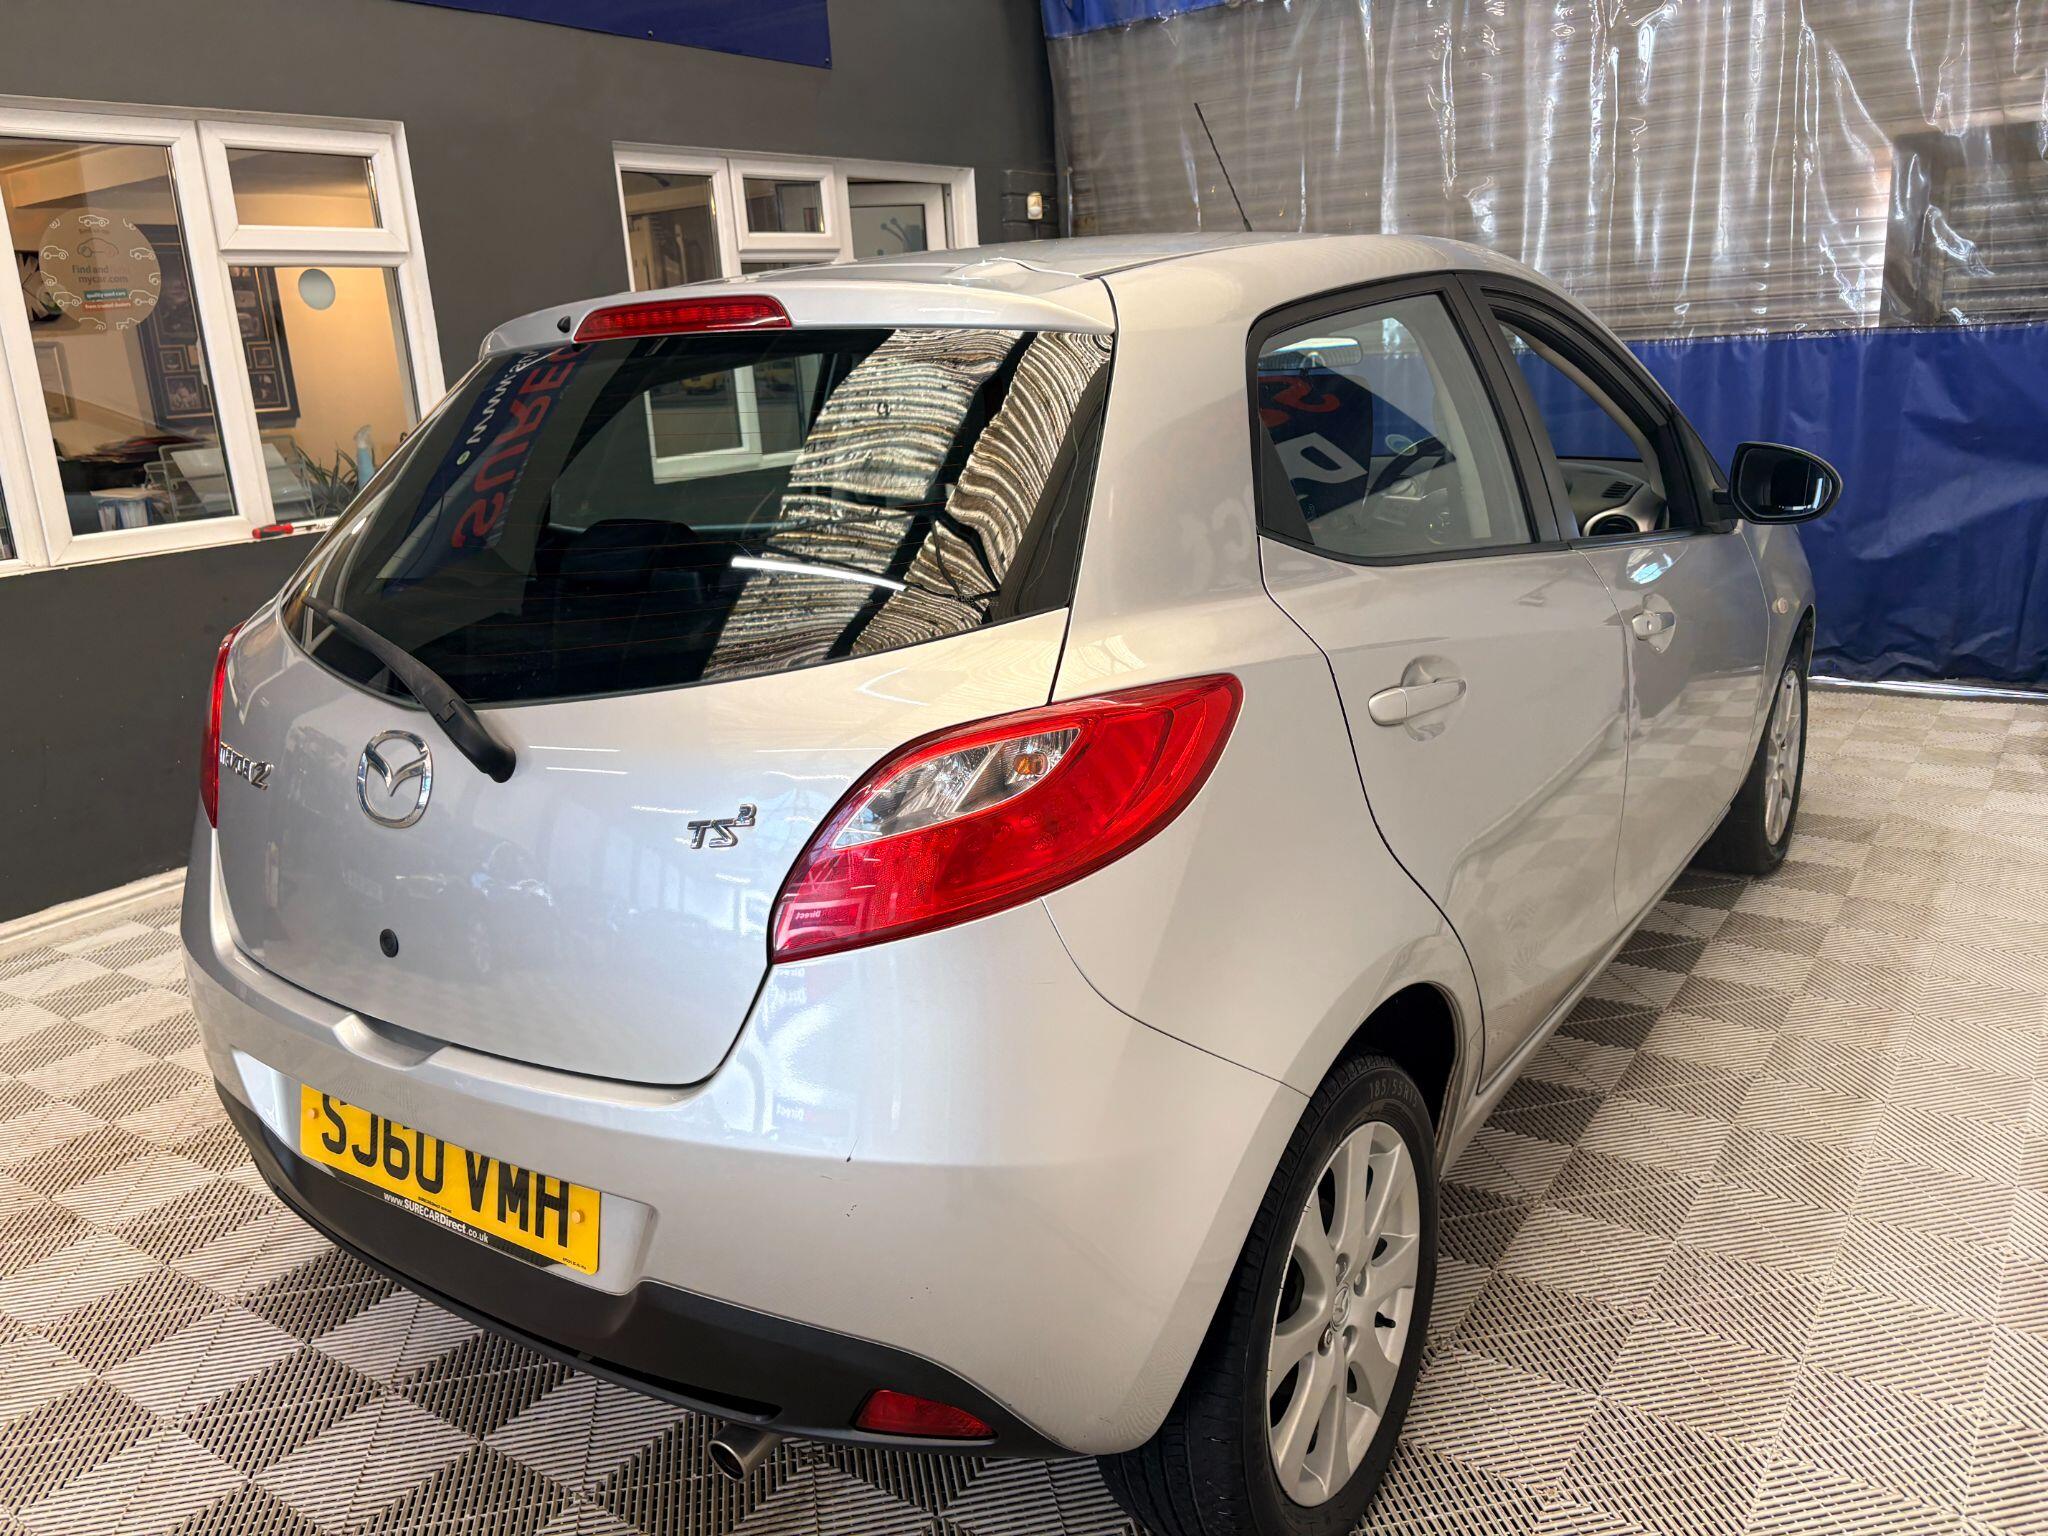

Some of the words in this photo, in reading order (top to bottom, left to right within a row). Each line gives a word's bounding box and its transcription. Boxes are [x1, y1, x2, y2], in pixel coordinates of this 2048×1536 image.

[321, 1093, 445, 1195] SJ60
[465, 1149, 570, 1249] VMH
[383, 1193, 489, 1244] www.SURECARDirect.co.uk
